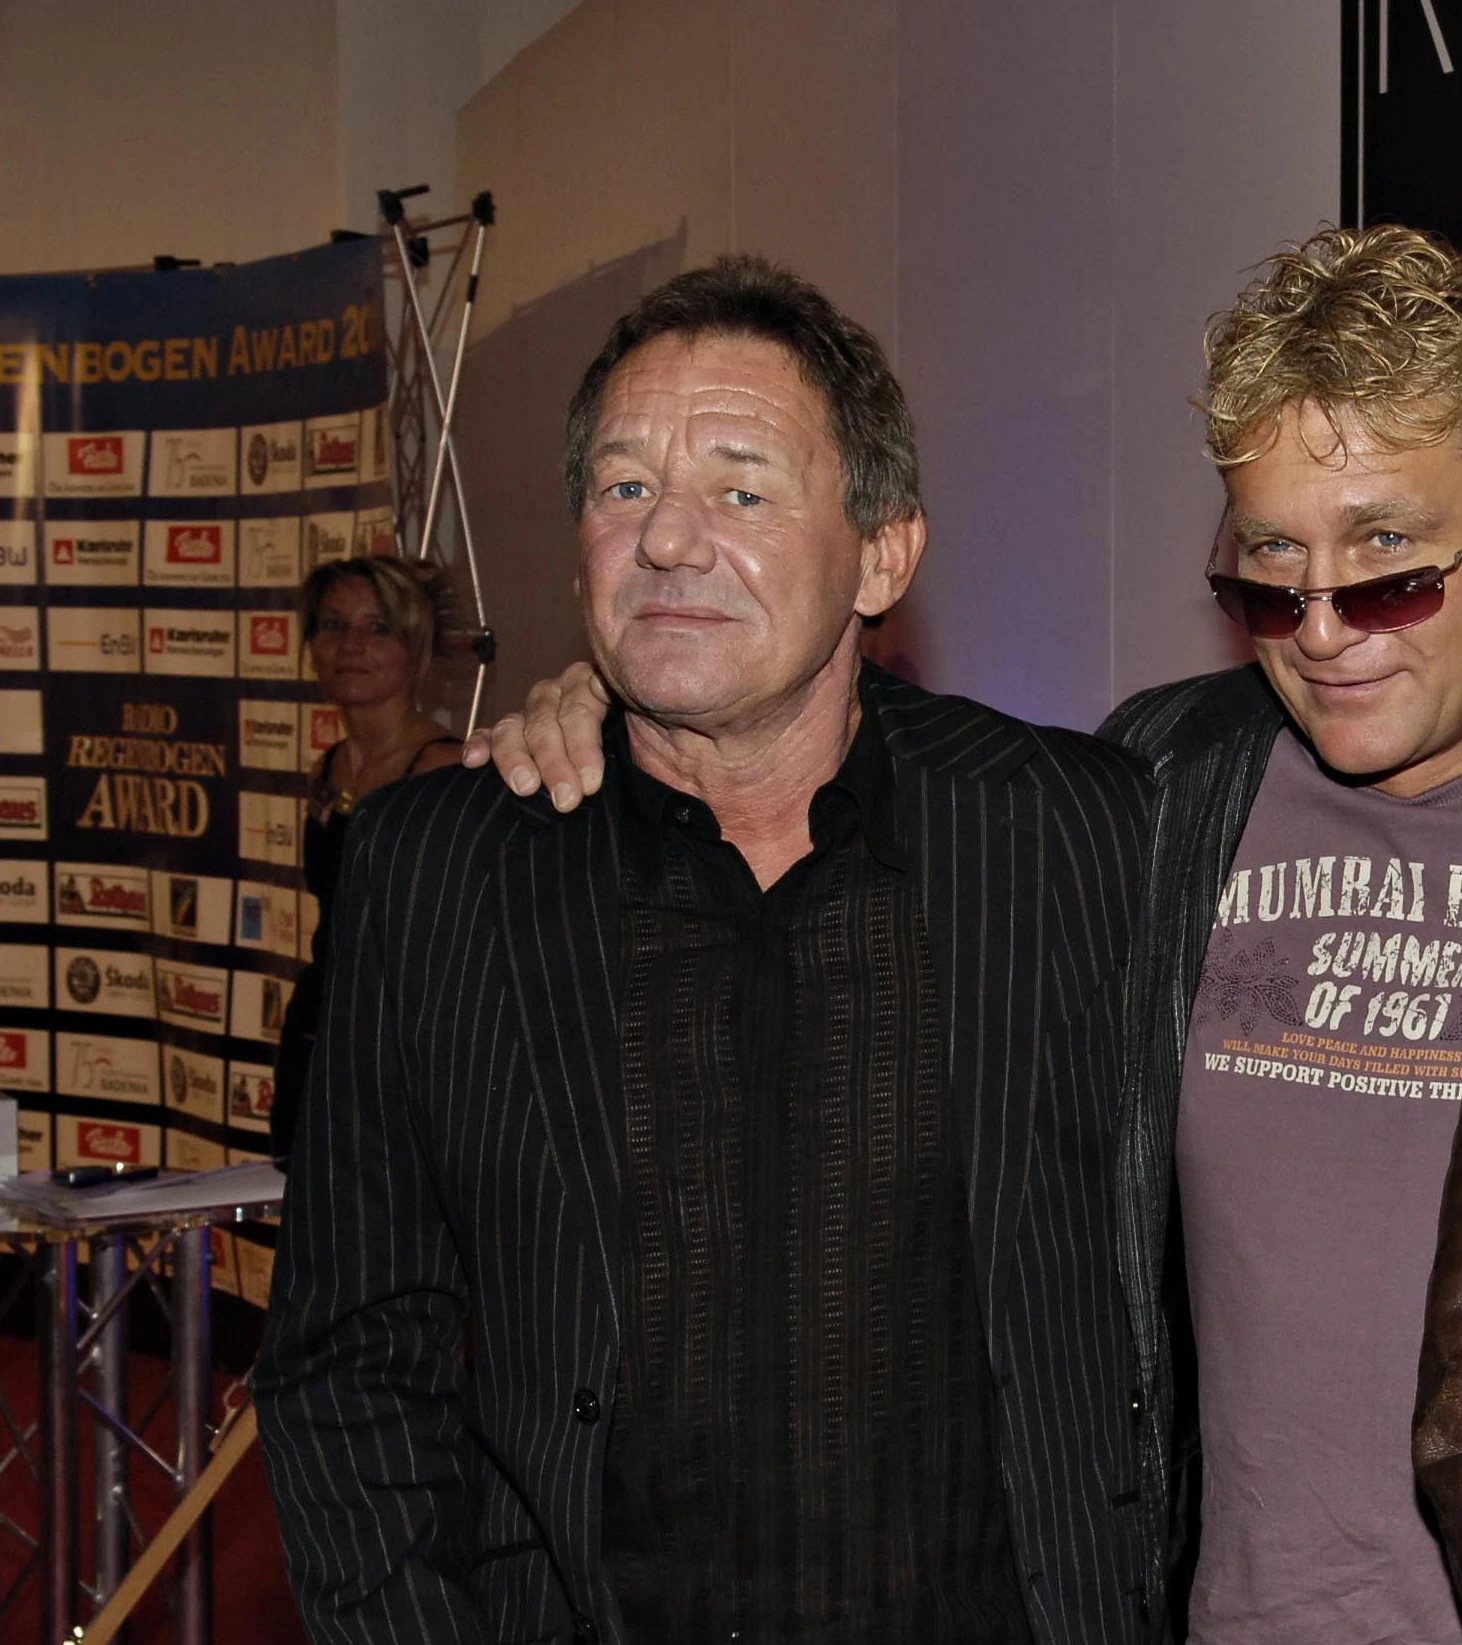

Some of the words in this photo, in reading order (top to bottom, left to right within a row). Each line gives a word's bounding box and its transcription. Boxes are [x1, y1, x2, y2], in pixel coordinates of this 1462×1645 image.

[227, 319, 336, 376] AWARD
[75, 773, 211, 838] AWARD
[1212, 856, 1425, 930] MUMBAI
[1304, 980, 1362, 1031] OF
[1363, 990, 1452, 1041] 1967
[1204, 1052, 1230, 1072] WE
[1234, 1055, 1324, 1087] SUPPORT
[1327, 1071, 1424, 1099] POSITIVE
[1223, 1039, 1251, 1053] WILL
[1253, 1043, 1289, 1058] MAKE
[1292, 1049, 1326, 1064] YOUR
[1328, 1054, 1361, 1070] DAYS
[1364, 1061, 1411, 1076] FILLED
[1414, 1065, 1448, 1077] WITH
[1282, 1032, 1315, 1046] LOVE
[1317, 1036, 1358, 1054] PEACE
[1360, 1043, 1387, 1058] AND
[1389, 1047, 1462, 1062] HAPPINESS
